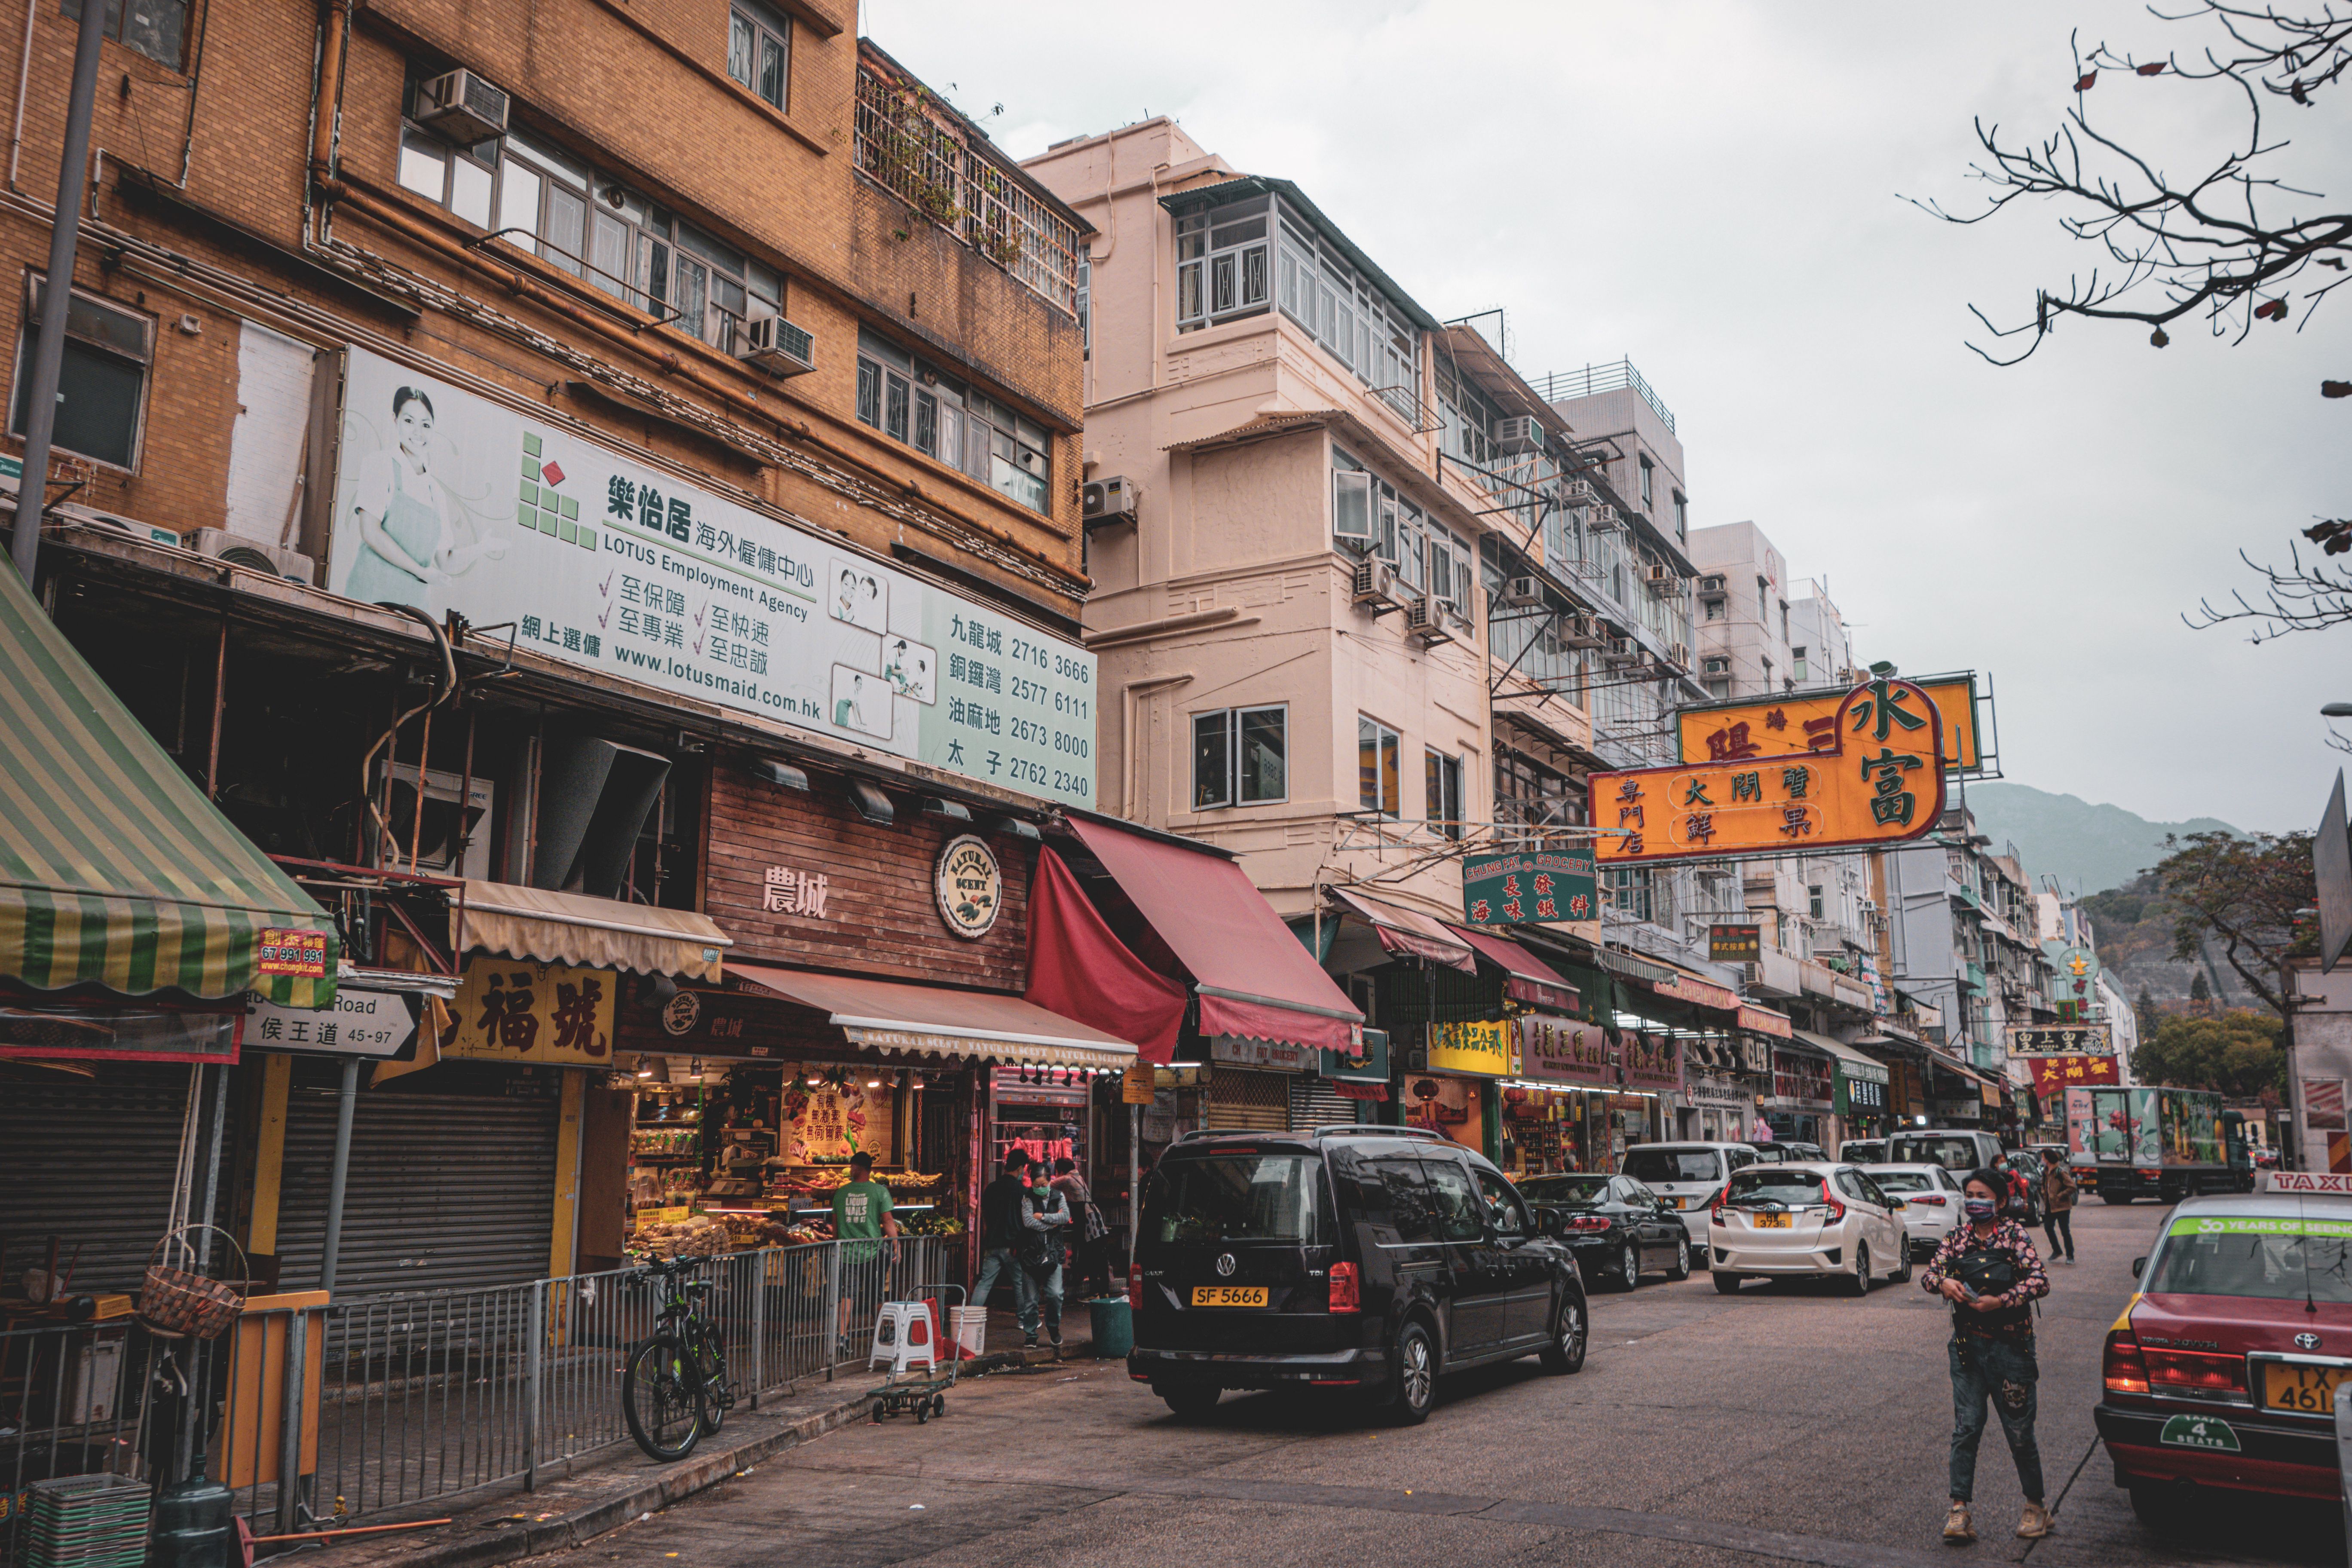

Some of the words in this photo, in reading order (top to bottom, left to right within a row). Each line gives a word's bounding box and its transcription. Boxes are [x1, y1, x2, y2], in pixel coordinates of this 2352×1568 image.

[608, 475, 691, 543] 樂怡居
[695, 521, 813, 588] 海外僱傭中心
[605, 534, 655, 565] LOTUS
[662, 554, 753, 601] Employment
[759, 591, 807, 622] Agency
[620, 574, 685, 617] 至保障
[521, 614, 600, 658] 網上選傭
[619, 606, 683, 649] 至專業
[711, 605, 769, 646] 至快速
[710, 636, 767, 676] 至忠誠
[951, 613, 1001, 656] 九龍城
[1012, 638, 1047, 669] 2716
[1055, 655, 1088, 683] 3666
[615, 646, 820, 720] www.lotusmaid.com.hk
[949, 652, 1001, 695] 銅鑼灣
[1012, 677, 1047, 705] 2577
[1055, 692, 1087, 720] 6111
[949, 695, 1000, 735] 油麻地
[1011, 717, 1047, 746] 2673
[1055, 731, 1087, 758] 8000
[1850, 679, 1927, 825] 永富
[1010, 757, 1046, 786] 2762
[1054, 770, 1087, 796] 2340
[1684, 766, 1809, 805] 大閘蟹
[1615, 778, 1645, 853] 專門店
[950, 851, 992, 880] NATURAL
[1466, 861, 1501, 878] CHUNG
[1503, 855, 1520, 869] FAT
[1537, 854, 1591, 871] GROCERY
[763, 866, 827, 919] 農城
[956, 877, 986, 891] SCENT
[1503, 873, 1555, 897] 長發
[1471, 894, 1590, 922] 海味紙料
[262, 946, 276, 960] 67
[280, 947, 300, 961] 991
[303, 949, 323, 963] 991
[261, 962, 323, 974] www.chongkit.com
[334, 995, 377, 1014] Road
[260, 1017, 338, 1045] 侯王道
[867, 1032, 924, 1046] NATURAL
[927, 1037, 960, 1050] SCENT
[968, 1041, 1017, 1054] NATURAL
[1019, 1046, 1047, 1057] SCENT
[1054, 1049, 1096, 1061] NATURAL
[1098, 1054, 1123, 1063] SCENT
[1257, 1047, 1268, 1059] FAT
[1272, 1048, 1298, 1062] GROCERY
[817, 1093, 836, 1109] 有機
[812, 1109, 840, 1125] 無激素
[807, 1125, 843, 1141] 無荷爾蒙
[2274, 1174, 2352, 1191] TAXI
[845, 1197, 868, 1206] LIQUID
[845, 1206, 867, 1216] NAILS
[2198, 1219, 2224, 1232] 30
[2229, 1221, 2278, 1231] YEARS
[2281, 1222, 2301, 1231] OF
[1197, 1289, 1216, 1304] SF
[1221, 1289, 1263, 1304] 5666
[2142, 1336, 2169, 1344] TOYOTA
[2291, 1366, 2331, 1390] TX
[2279, 1386, 2334, 1411] 461
[2177, 1434, 2223, 1447] SEATS
[2192, 1422, 2207, 1437] 4
